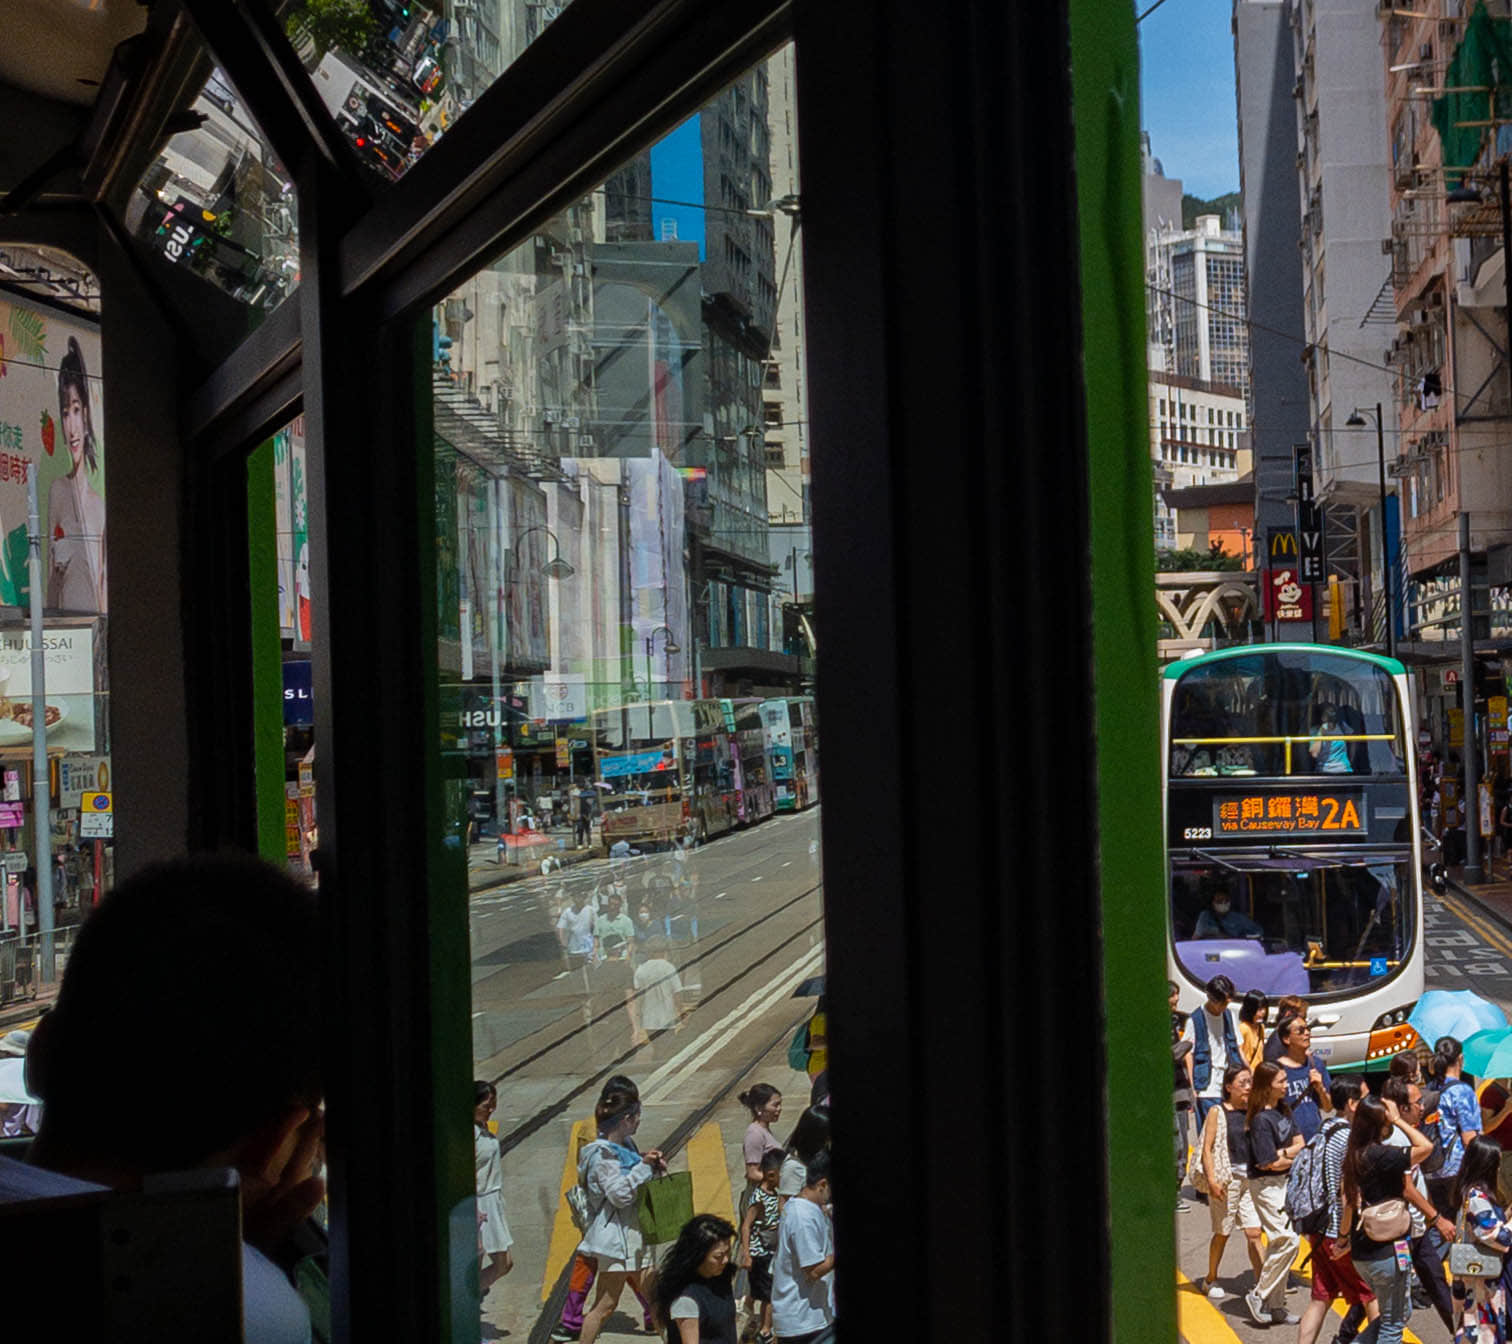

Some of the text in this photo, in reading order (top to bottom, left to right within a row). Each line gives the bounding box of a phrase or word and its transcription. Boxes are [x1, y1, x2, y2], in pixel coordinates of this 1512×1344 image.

[1320, 797, 1361, 830] 2A
[1221, 816, 1320, 832] via Causeway Bay
[1184, 827, 1212, 840] 5223
